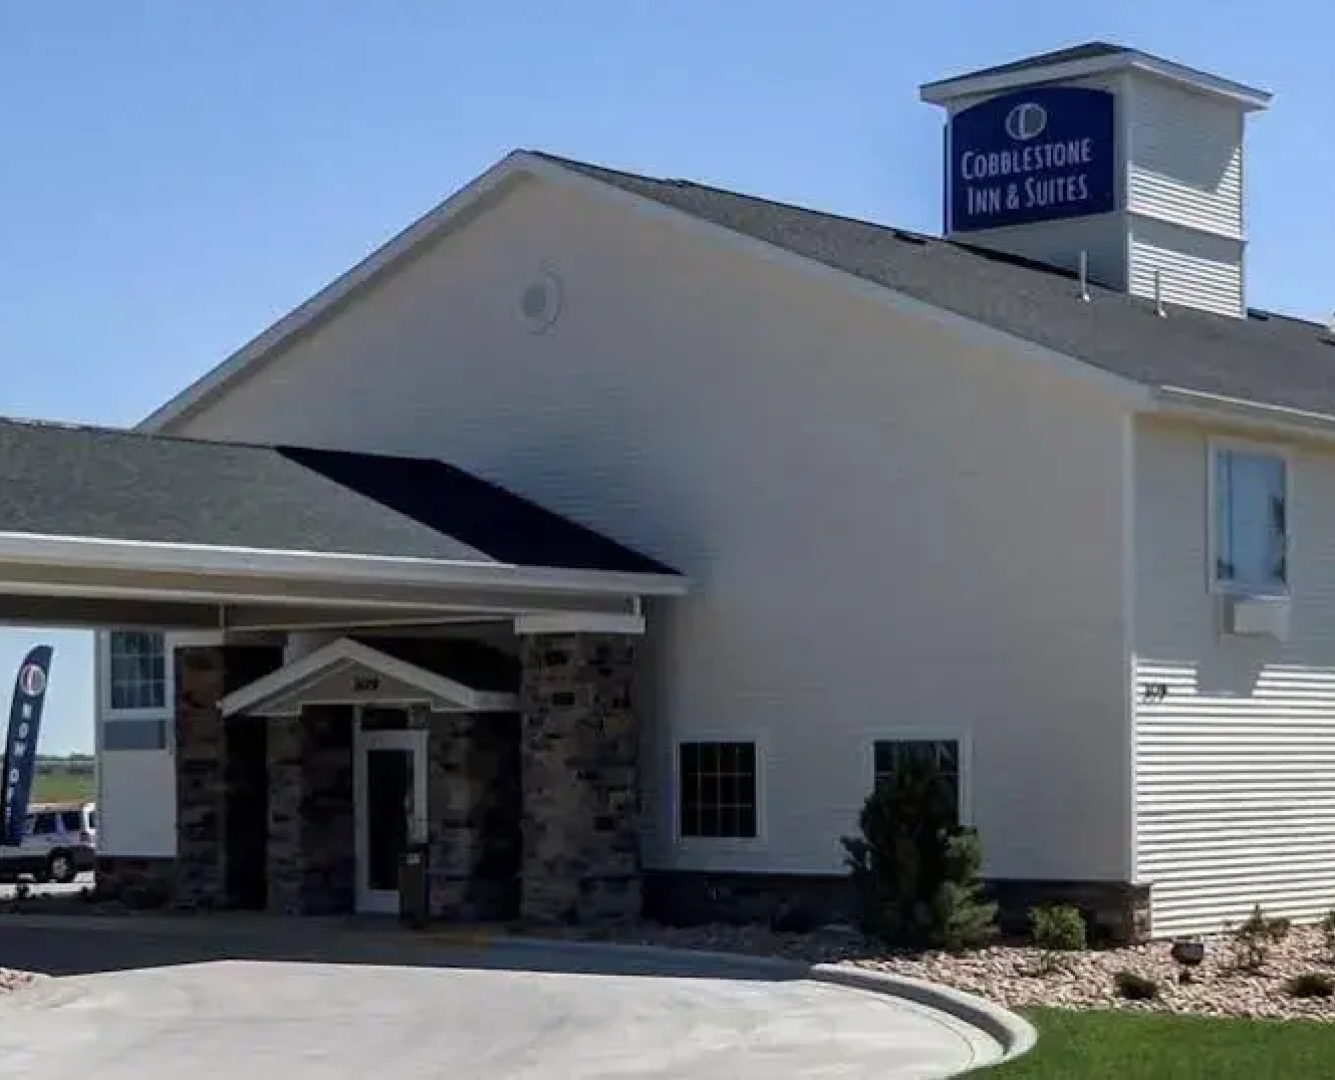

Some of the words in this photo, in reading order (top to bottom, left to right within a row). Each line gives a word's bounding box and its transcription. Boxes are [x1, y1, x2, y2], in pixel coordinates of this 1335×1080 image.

[961, 138, 1093, 180] COBBLESTONE
[967, 186, 1002, 216] INN
[1006, 183, 1020, 210] &
[1024, 174, 1088, 208] SUITES
[14, 703, 32, 757] NOW
